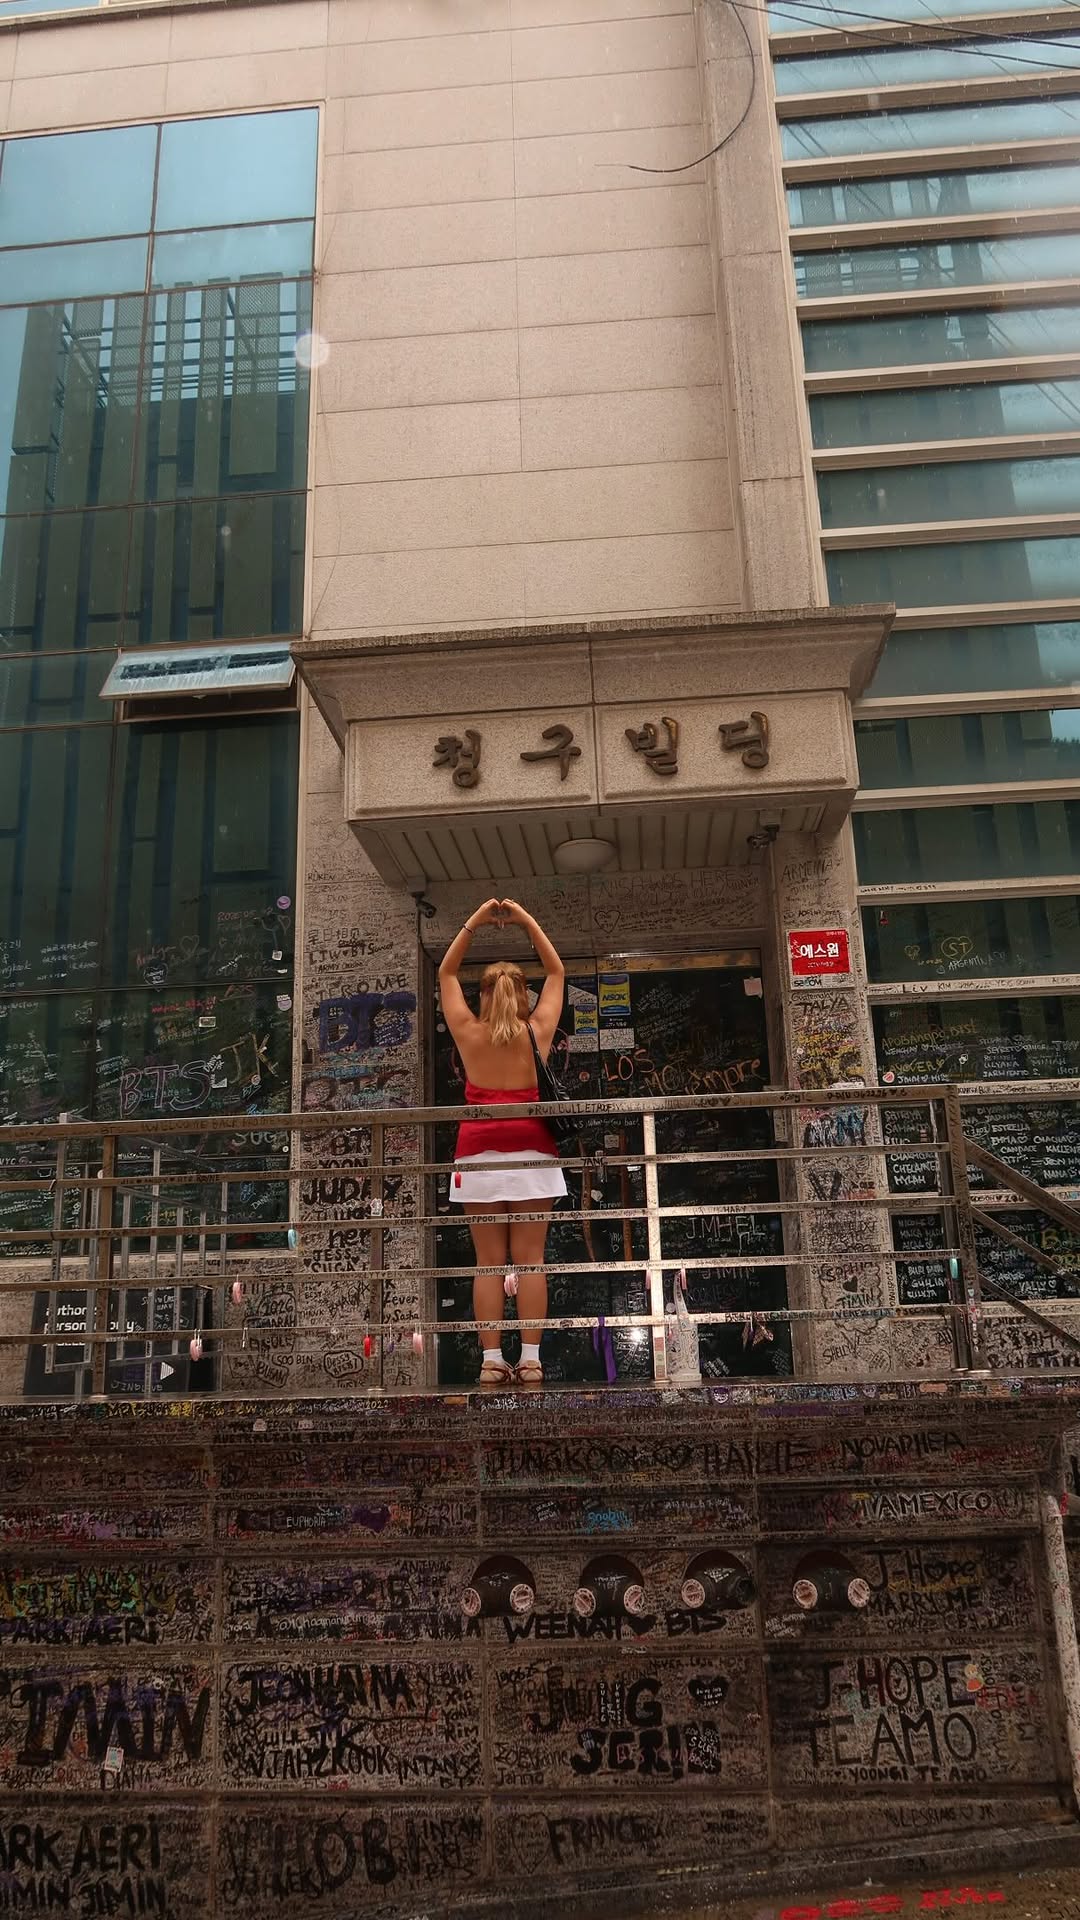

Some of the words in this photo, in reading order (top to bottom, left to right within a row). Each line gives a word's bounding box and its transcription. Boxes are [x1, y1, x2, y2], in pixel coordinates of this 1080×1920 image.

[432, 710, 770, 789] 청구빌딩
[799, 942, 840, 959] 에스원
[902, 982, 928, 993] Liv
[120, 1060, 212, 1117] BTS
[898, 1490, 992, 1516] MEXICO
[286, 1514, 327, 1528] EUPHORIA
[503, 1612, 623, 1644] WEENAH
[667, 1608, 727, 1637] BTS
[867, 1709, 979, 1766] AMO
